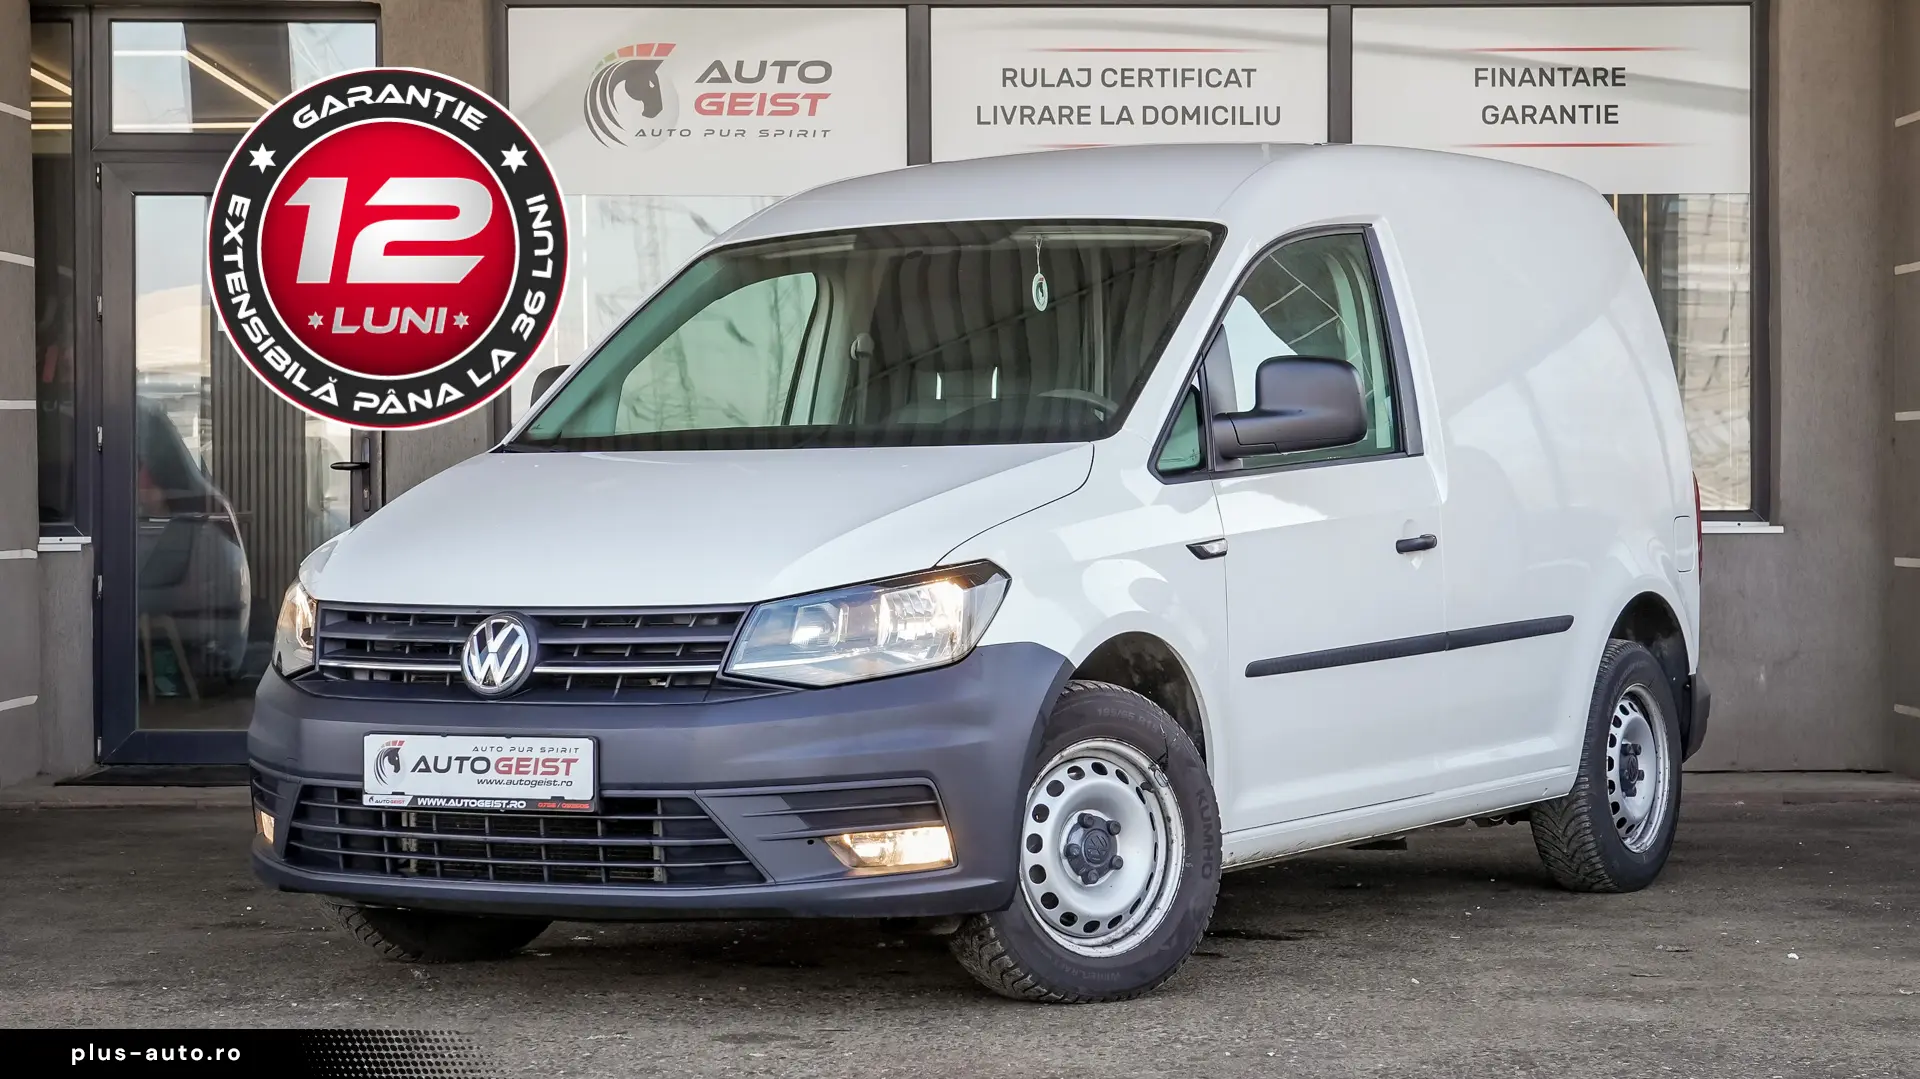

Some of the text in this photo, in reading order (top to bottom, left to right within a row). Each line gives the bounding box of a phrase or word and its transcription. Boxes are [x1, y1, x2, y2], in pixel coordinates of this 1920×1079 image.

[694, 59, 833, 84] AUTO
[1001, 67, 1257, 88] RULAJ CERTIFICAT
[1474, 67, 1626, 88] FINANTARE
[694, 92, 832, 116] GEIST
[1481, 104, 1619, 125] GARANTIE
[976, 105, 1282, 126] LIVRARE LA DOMICILIU
[634, 127, 832, 138] AUTO PUR SPIRIT
[476, 778, 573, 788] www.autogeist.ro
[417, 797, 527, 809] WWW.AUTOGEIST.RO
[1196, 788, 1213, 881] KUMHO
